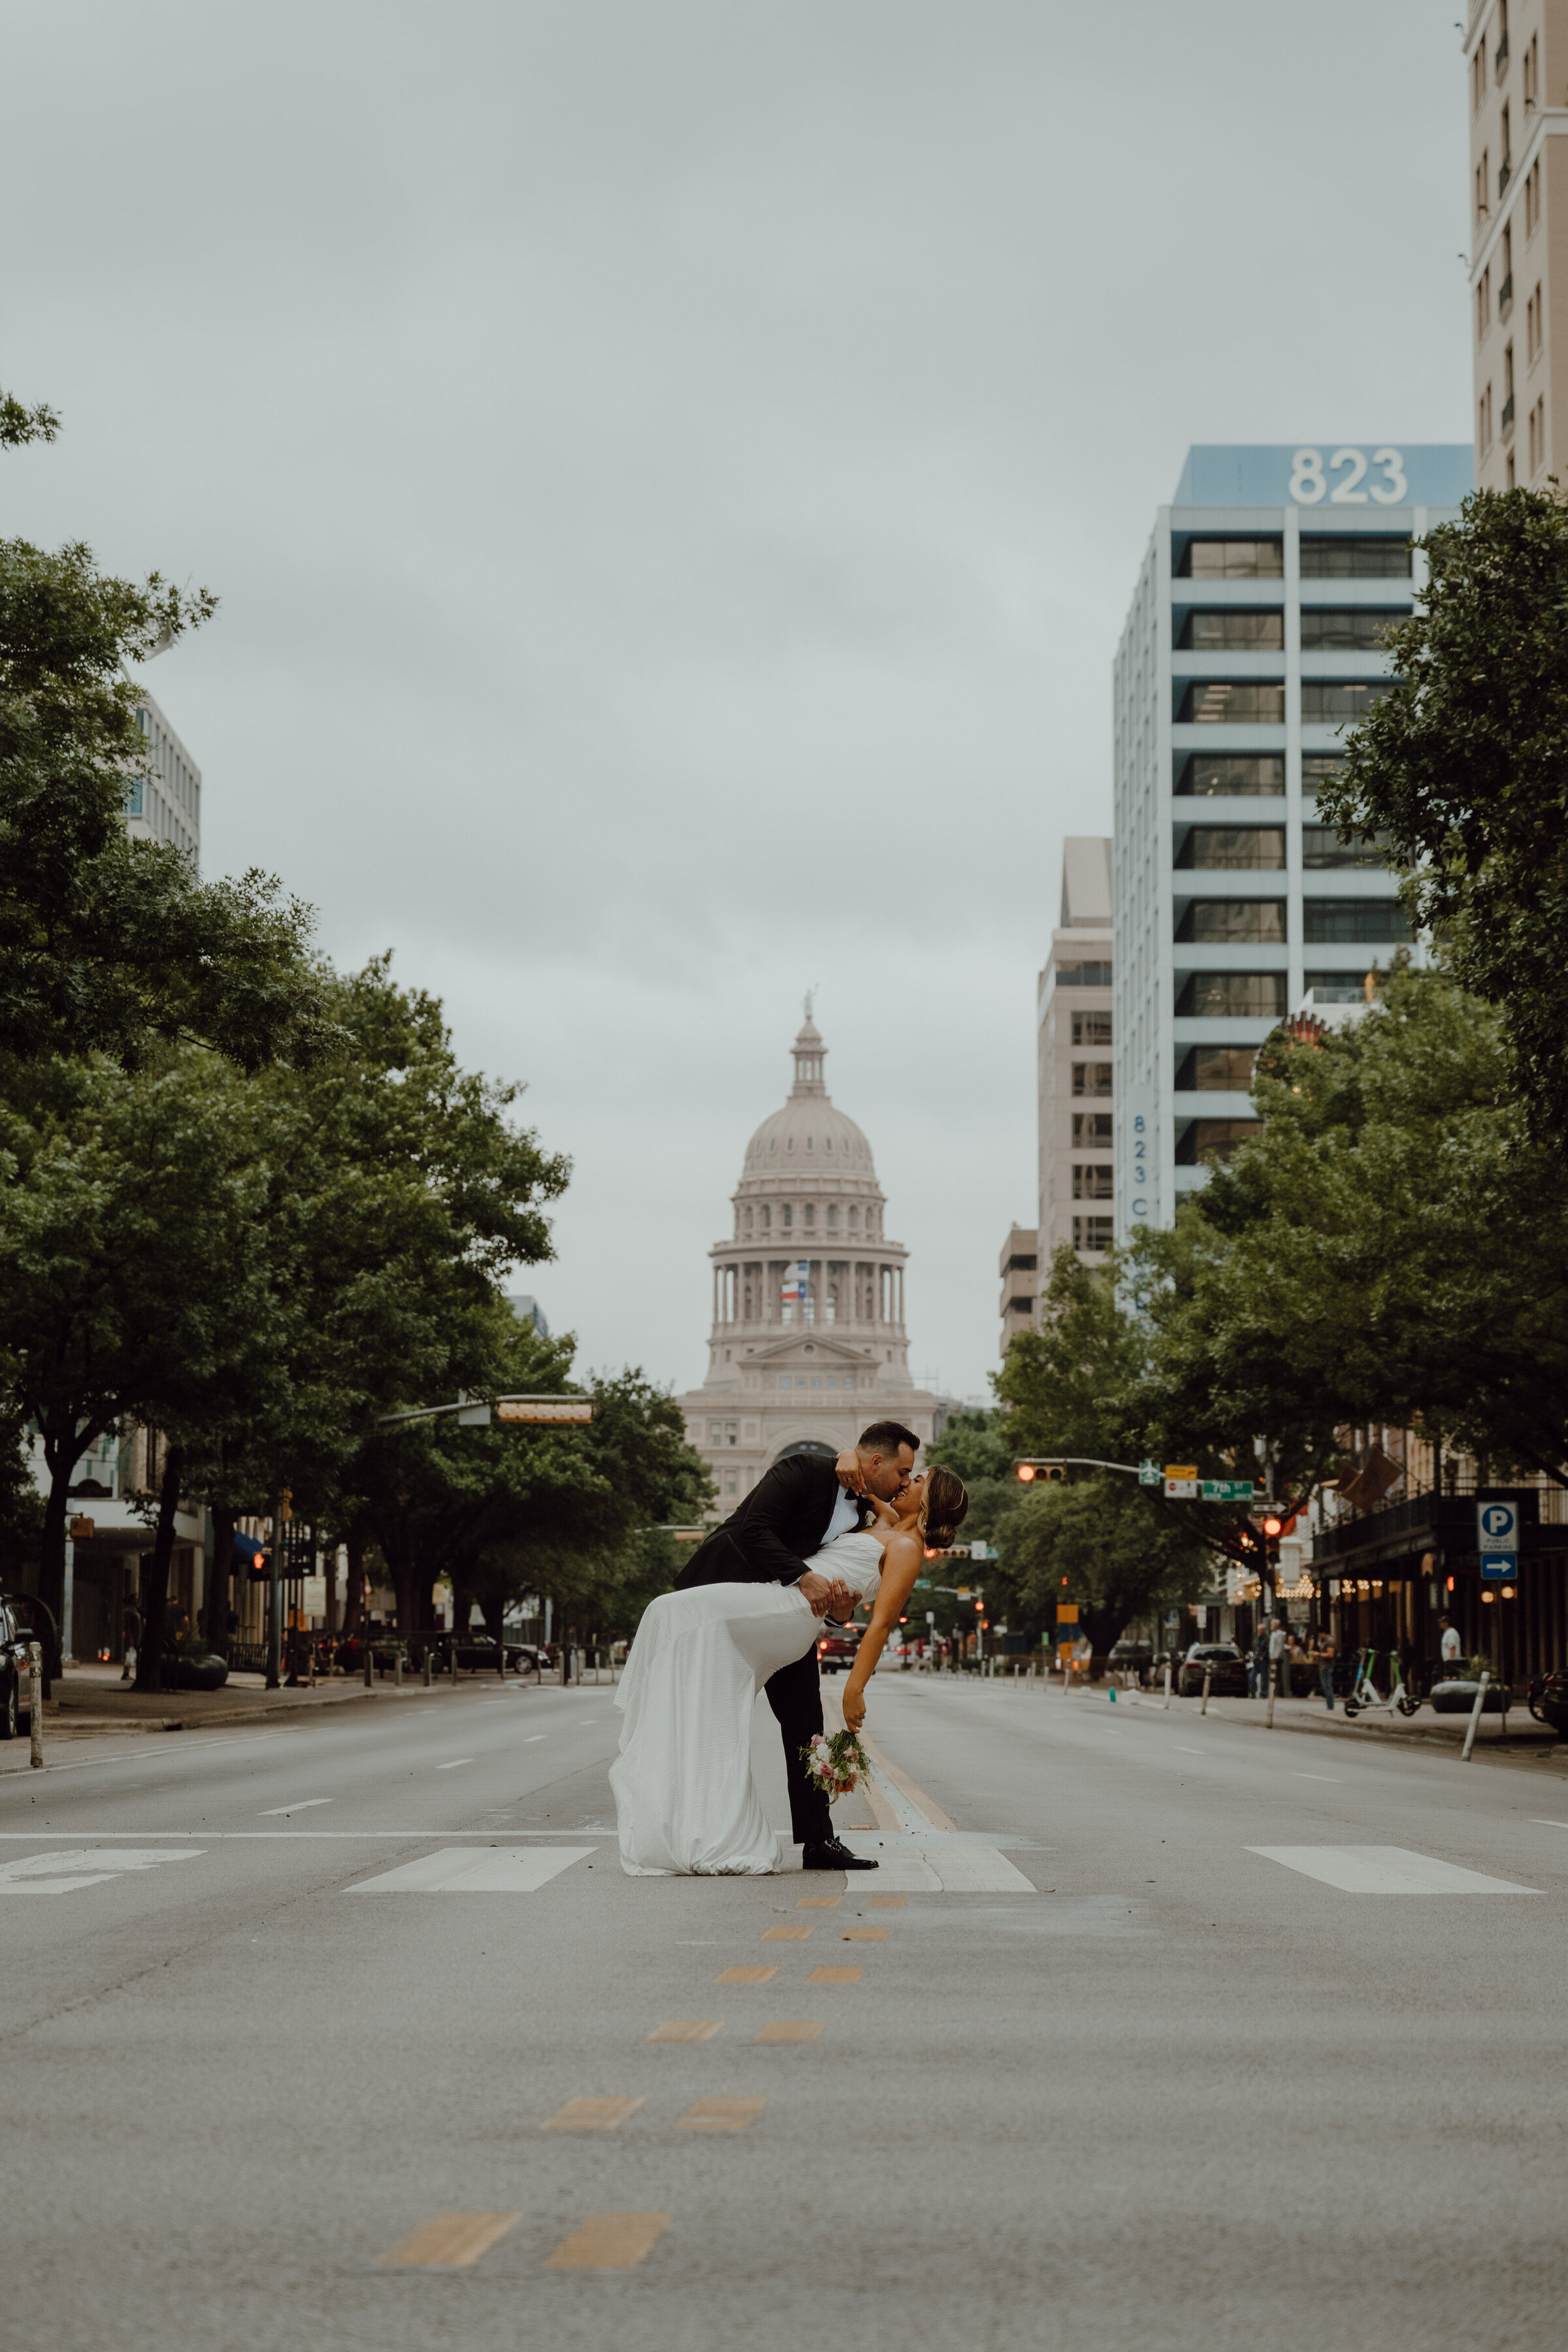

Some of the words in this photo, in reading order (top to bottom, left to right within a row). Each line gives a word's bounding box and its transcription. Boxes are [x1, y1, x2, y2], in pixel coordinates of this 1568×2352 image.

[1289, 448, 1407, 505] 823
[1134, 1116, 1145, 1183] 823
[1212, 1481, 1231, 1494] 7th
[1490, 1511, 1508, 1533] P
